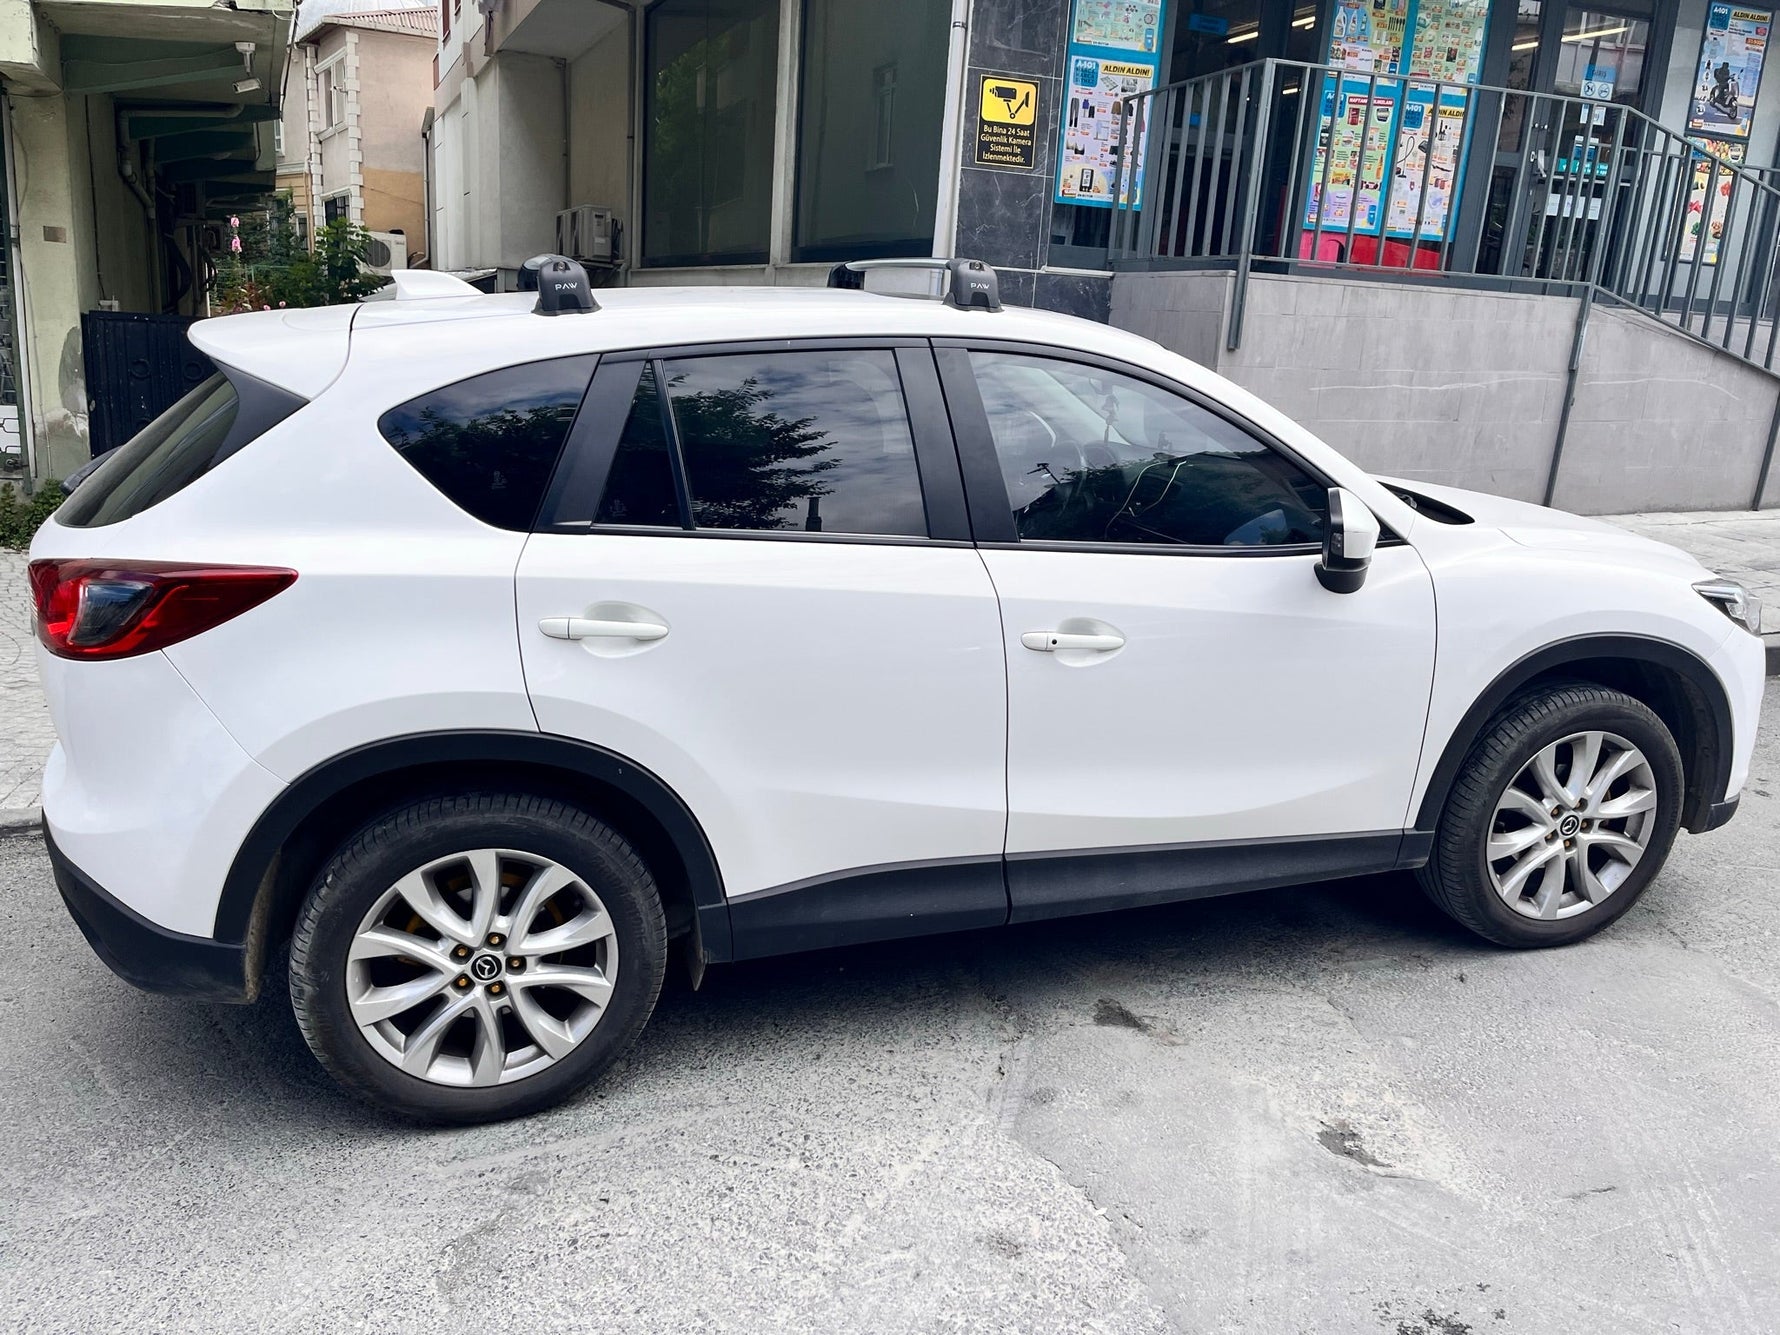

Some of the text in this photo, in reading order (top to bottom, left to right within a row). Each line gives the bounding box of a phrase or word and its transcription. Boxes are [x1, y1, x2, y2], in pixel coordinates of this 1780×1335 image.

[1076, 60, 1096, 69] A101
[1103, 65, 1150, 76] ALDIN ALDIN!
[983, 124, 992, 132] Bu
[993, 126, 1006, 134] Bina
[1016, 128, 1030, 136] Saat
[980, 134, 1032, 146] Güvenlik Kamera
[990, 144, 1012, 152] Sistemi
[554, 282, 578, 290] PAW
